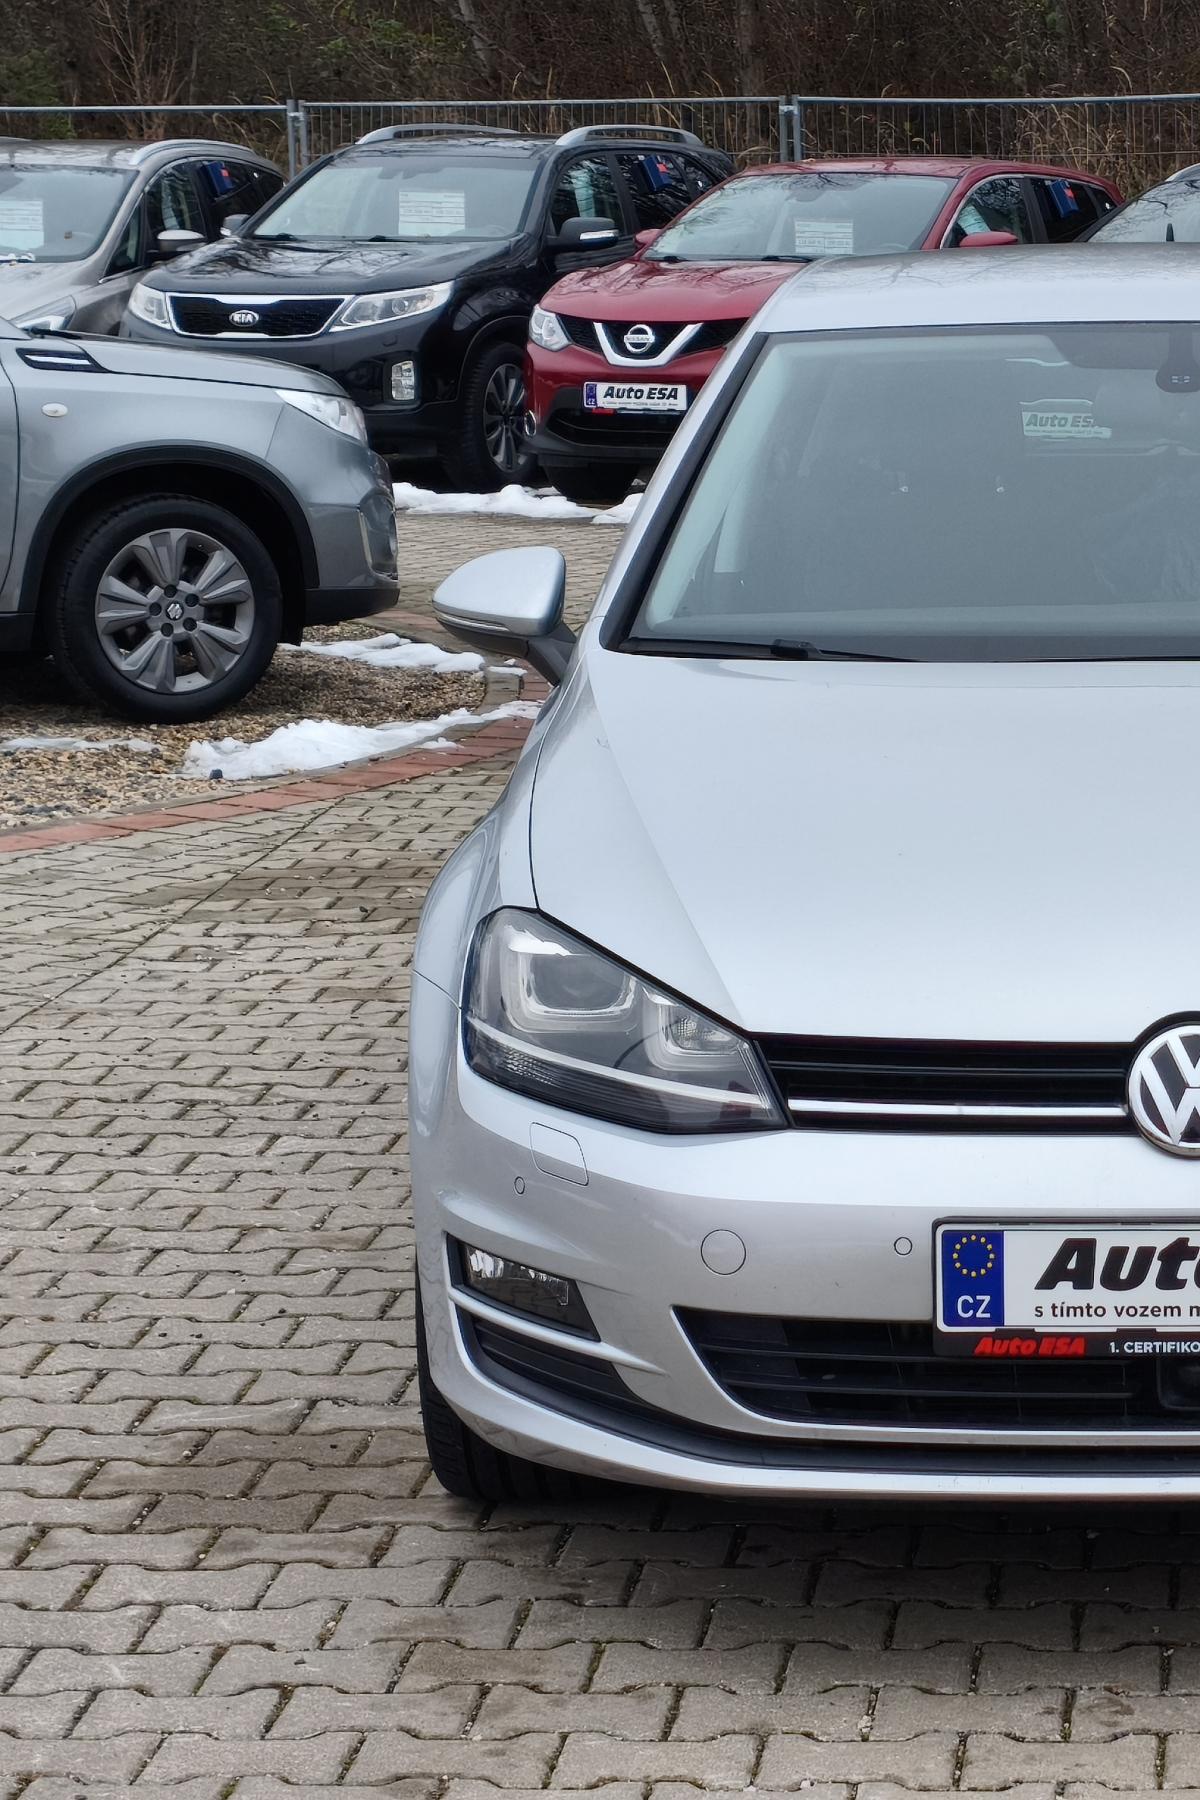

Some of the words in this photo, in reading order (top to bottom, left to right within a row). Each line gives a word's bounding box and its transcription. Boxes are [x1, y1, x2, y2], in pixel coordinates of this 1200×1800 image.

[603, 386, 644, 399] Auto
[646, 387, 678, 400] ESA
[1025, 413, 1068, 428] Auto
[957, 1295, 991, 1318] CZ
[1034, 1306, 1044, 1318] s
[1051, 1301, 1106, 1318] tímto
[1114, 1305, 1182, 1318] vozem
[974, 1337, 1037, 1356] Auto
[1038, 1336, 1086, 1355] ESA
[1109, 1341, 1120, 1353] 1.
